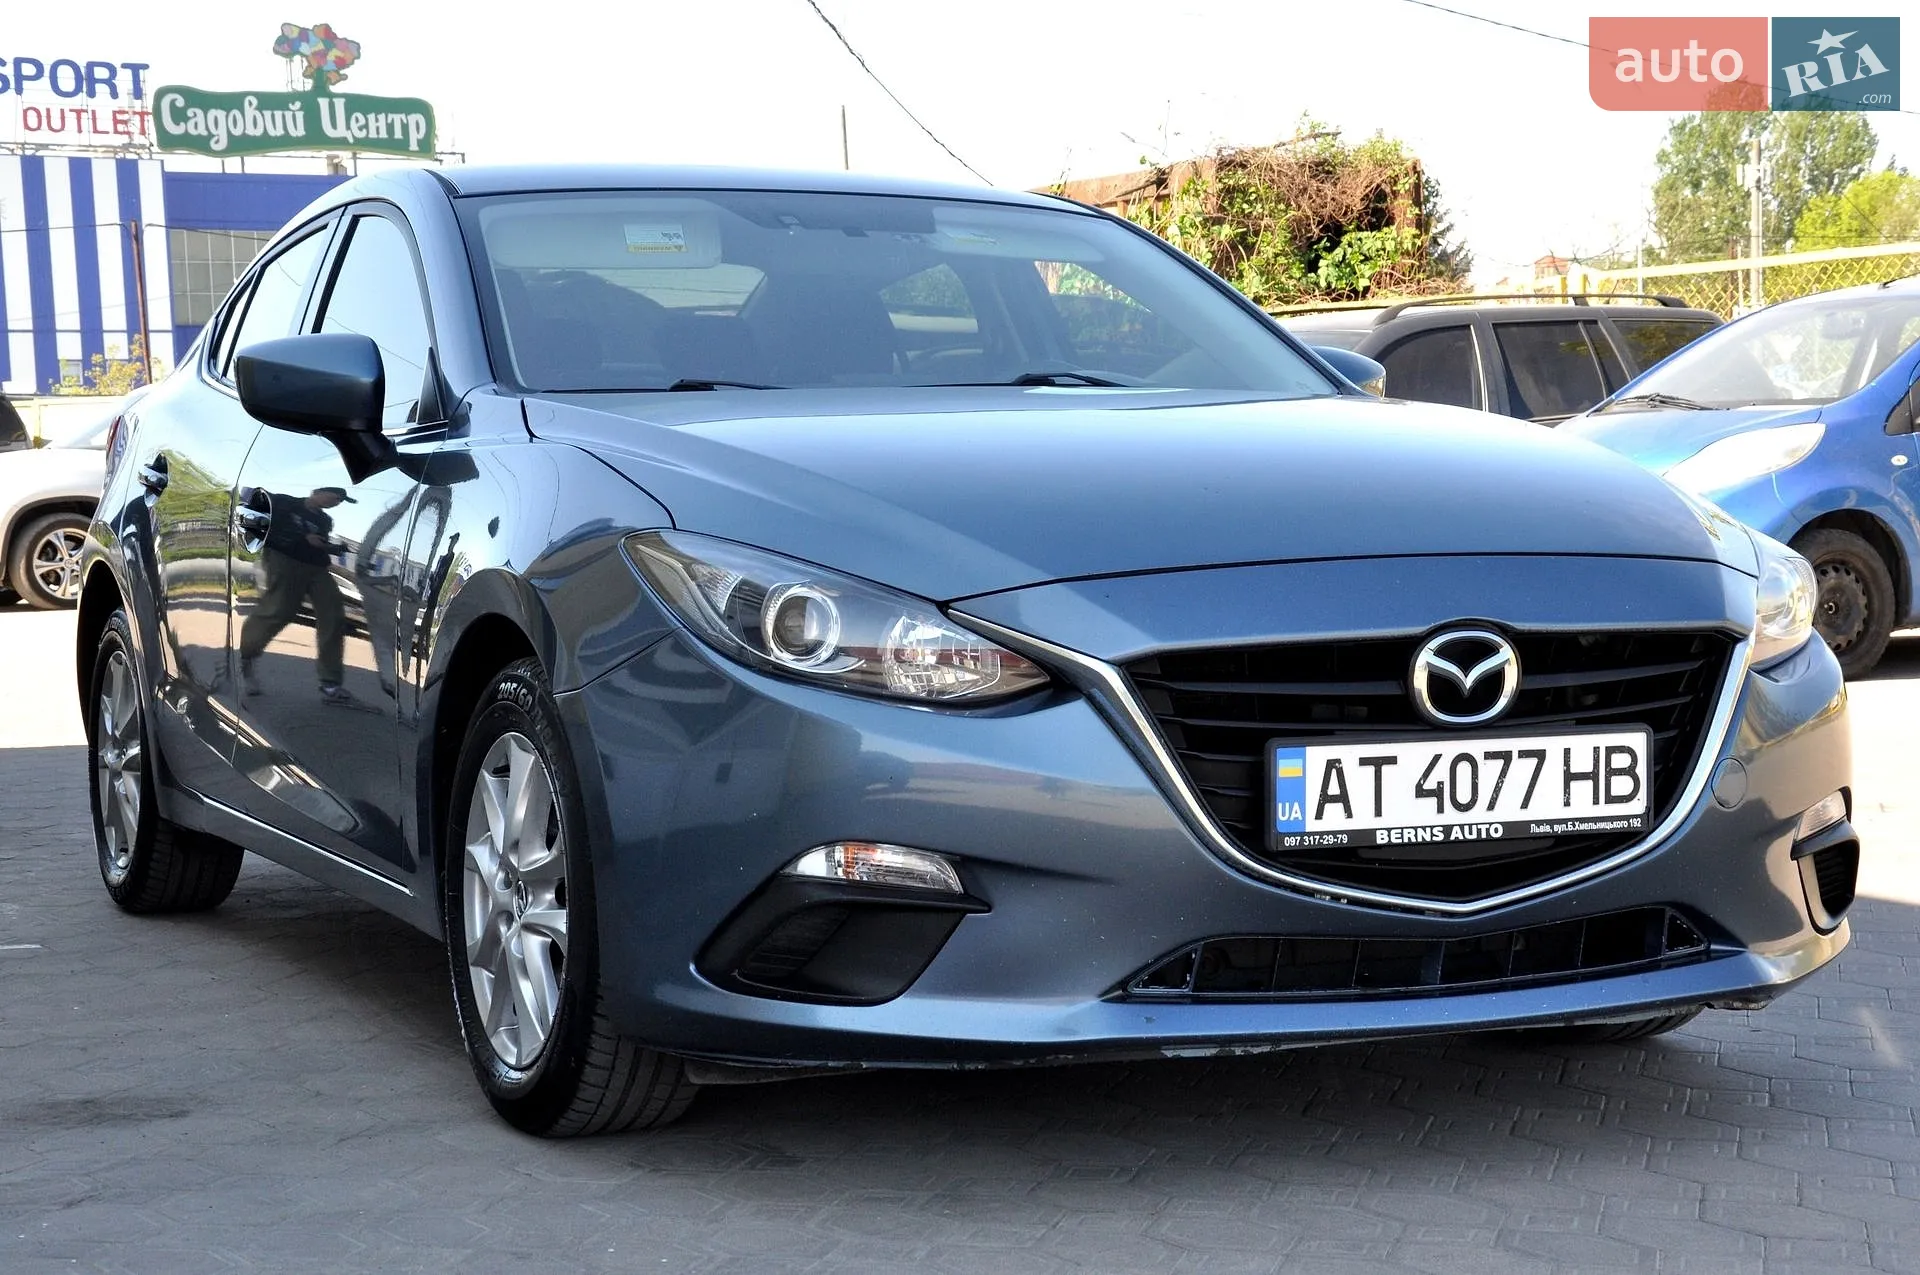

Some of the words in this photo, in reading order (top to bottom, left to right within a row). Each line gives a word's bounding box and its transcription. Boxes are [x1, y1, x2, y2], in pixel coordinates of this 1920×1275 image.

[22, 106, 152, 136] OUTLET
[161, 93, 306, 151] Садовий
[317, 97, 426, 151] Центр
[1314, 756, 1398, 820] AT
[1415, 749, 1546, 813] 4077
[1563, 746, 1641, 807] HB
[1278, 801, 1303, 821] UA
[1376, 826, 1445, 845] BERNS
[1449, 823, 1504, 840] AUTO
[1629, 818, 1642, 828] 192
[1284, 836, 1301, 847] 097
[1303, 834, 1349, 846] 317-29-79
